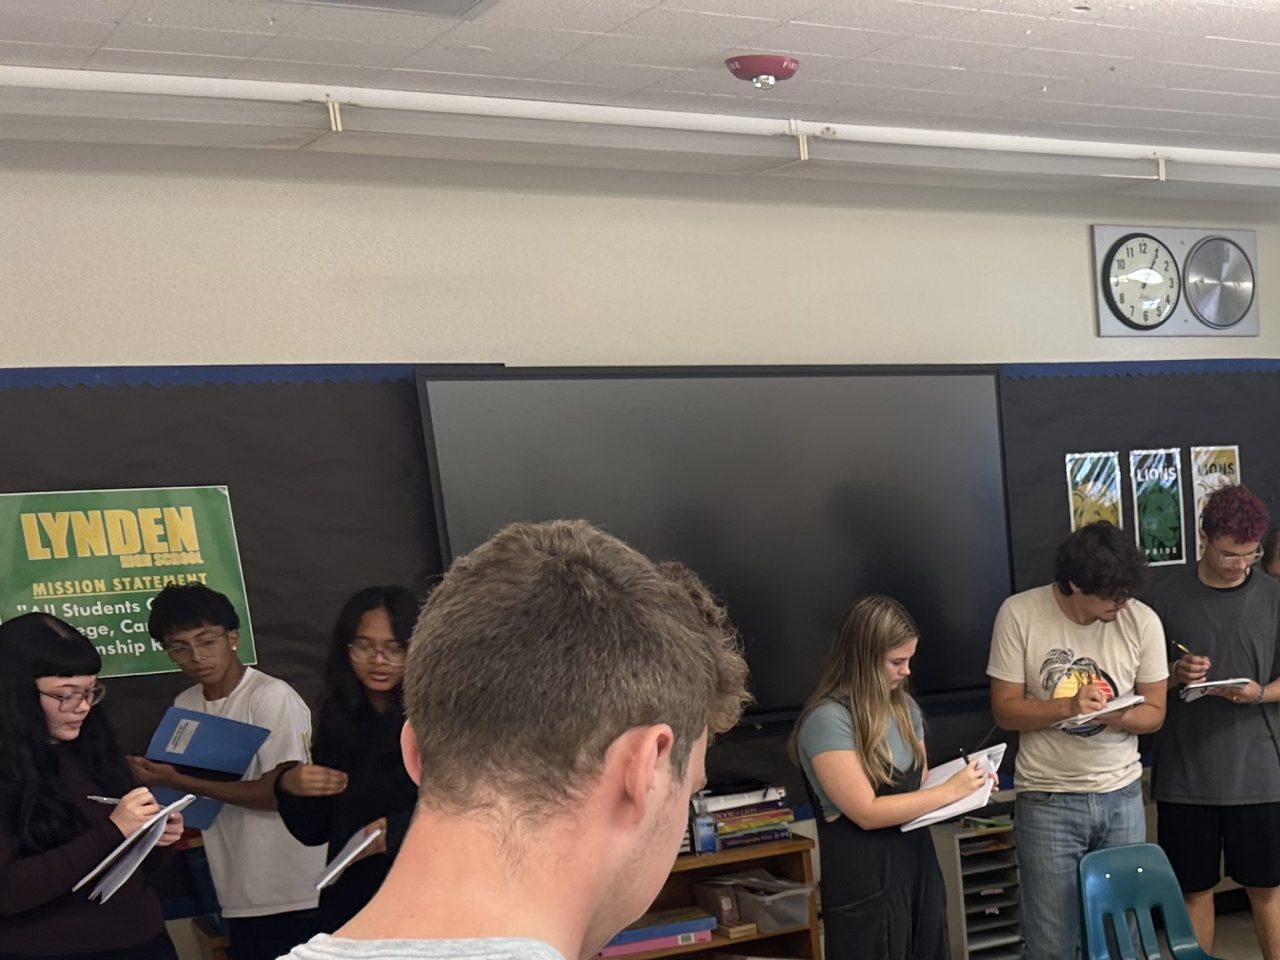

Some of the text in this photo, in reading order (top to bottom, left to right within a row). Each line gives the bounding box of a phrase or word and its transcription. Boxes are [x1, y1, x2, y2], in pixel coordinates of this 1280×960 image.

[1126, 247, 1134, 258] 11
[1139, 242, 1148, 254] 12
[1117, 258, 1125, 270] 10
[1164, 260, 1169, 272] 2
[1169, 277, 1174, 288] 3
[1119, 293, 1125, 304] 8
[1130, 305, 1135, 317] 7
[1143, 310, 1149, 321] 6
[1156, 306, 1162, 317] 5
[1136, 466, 1177, 482] LIONS
[20, 506, 200, 560] LYNDEN
[32, 572, 208, 597] MISSION STATEMENT
[63, 600, 141, 618] Students
[78, 624, 115, 639] ege,
[95, 639, 146, 657] nship
